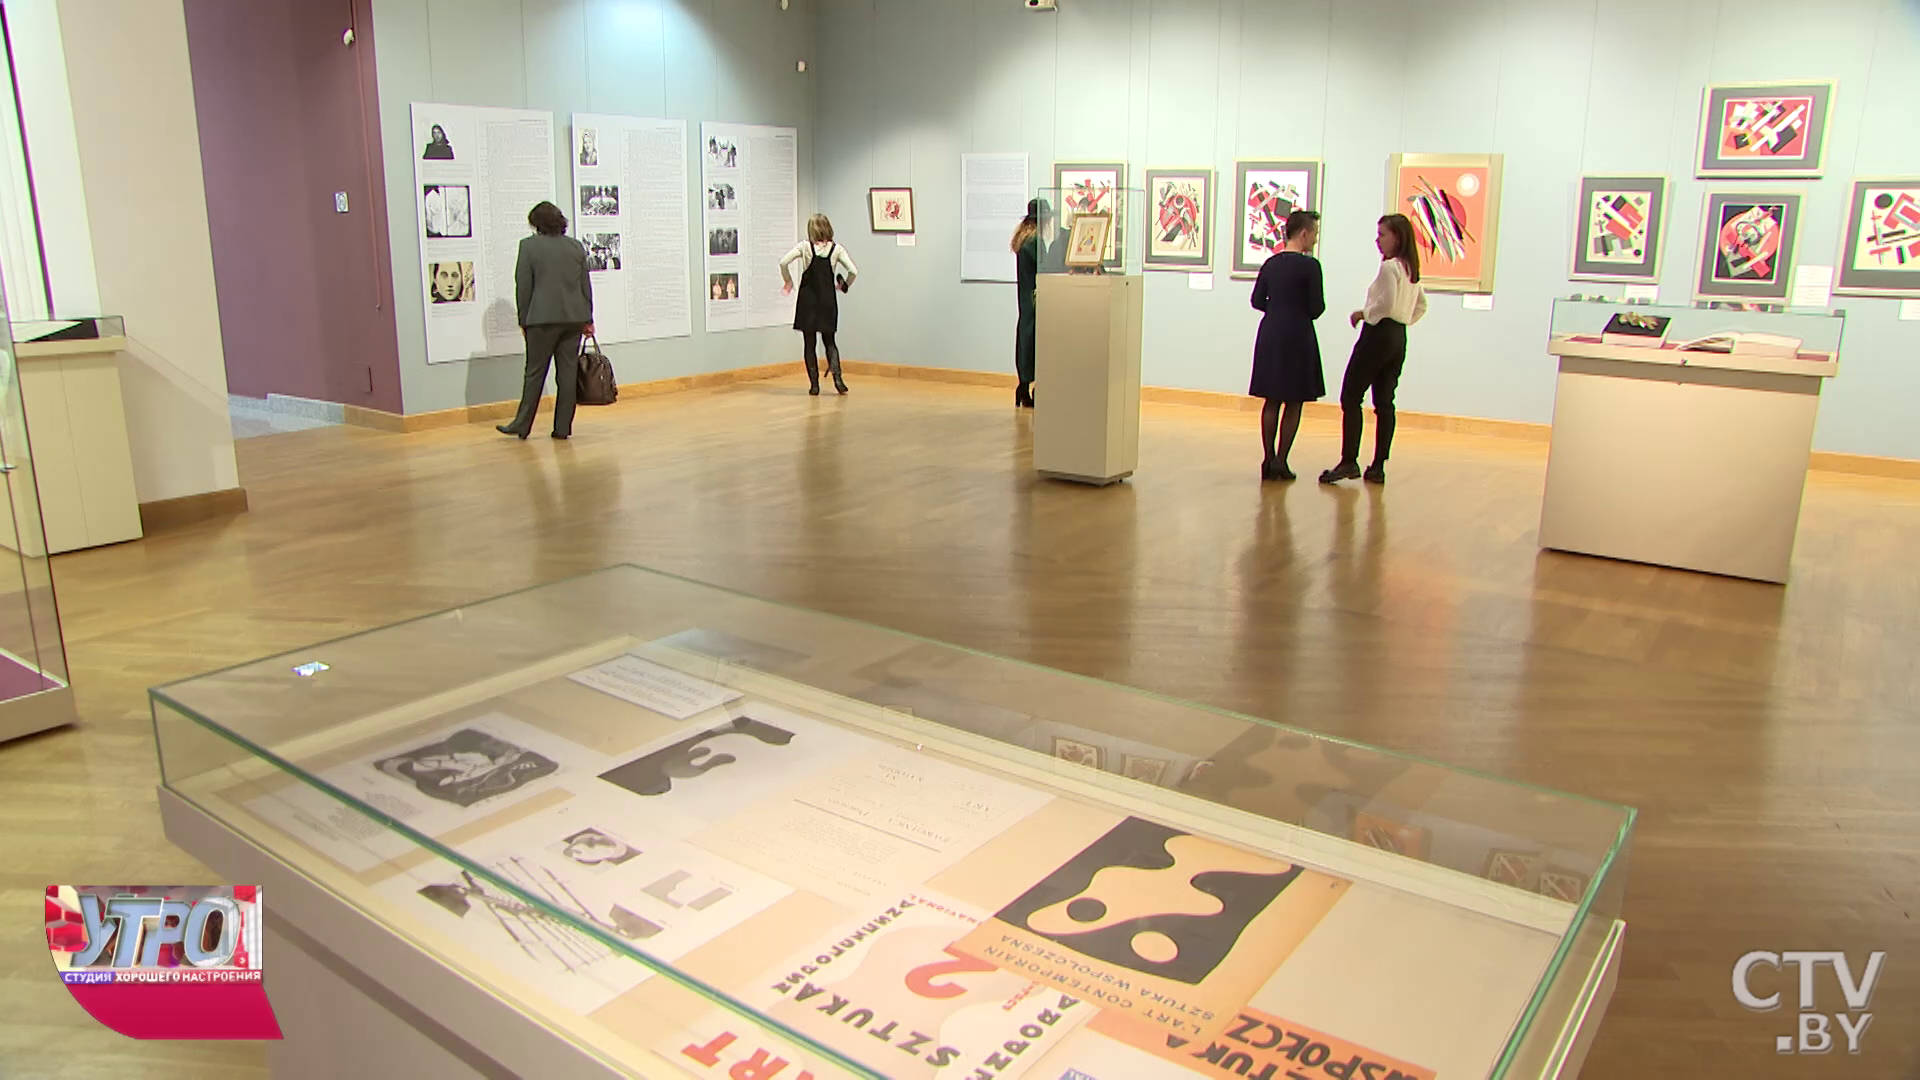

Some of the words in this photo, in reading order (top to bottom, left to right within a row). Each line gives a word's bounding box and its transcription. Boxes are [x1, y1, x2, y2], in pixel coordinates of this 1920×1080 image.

[905, 941, 1000, 999] 2
[984, 945, 1133, 1009] CONTEMPORAIN
[794, 982, 961, 1067] SZTUKA
[1139, 987, 1216, 1021] SZTUKA
[1142, 1009, 1202, 1035] L'ART
